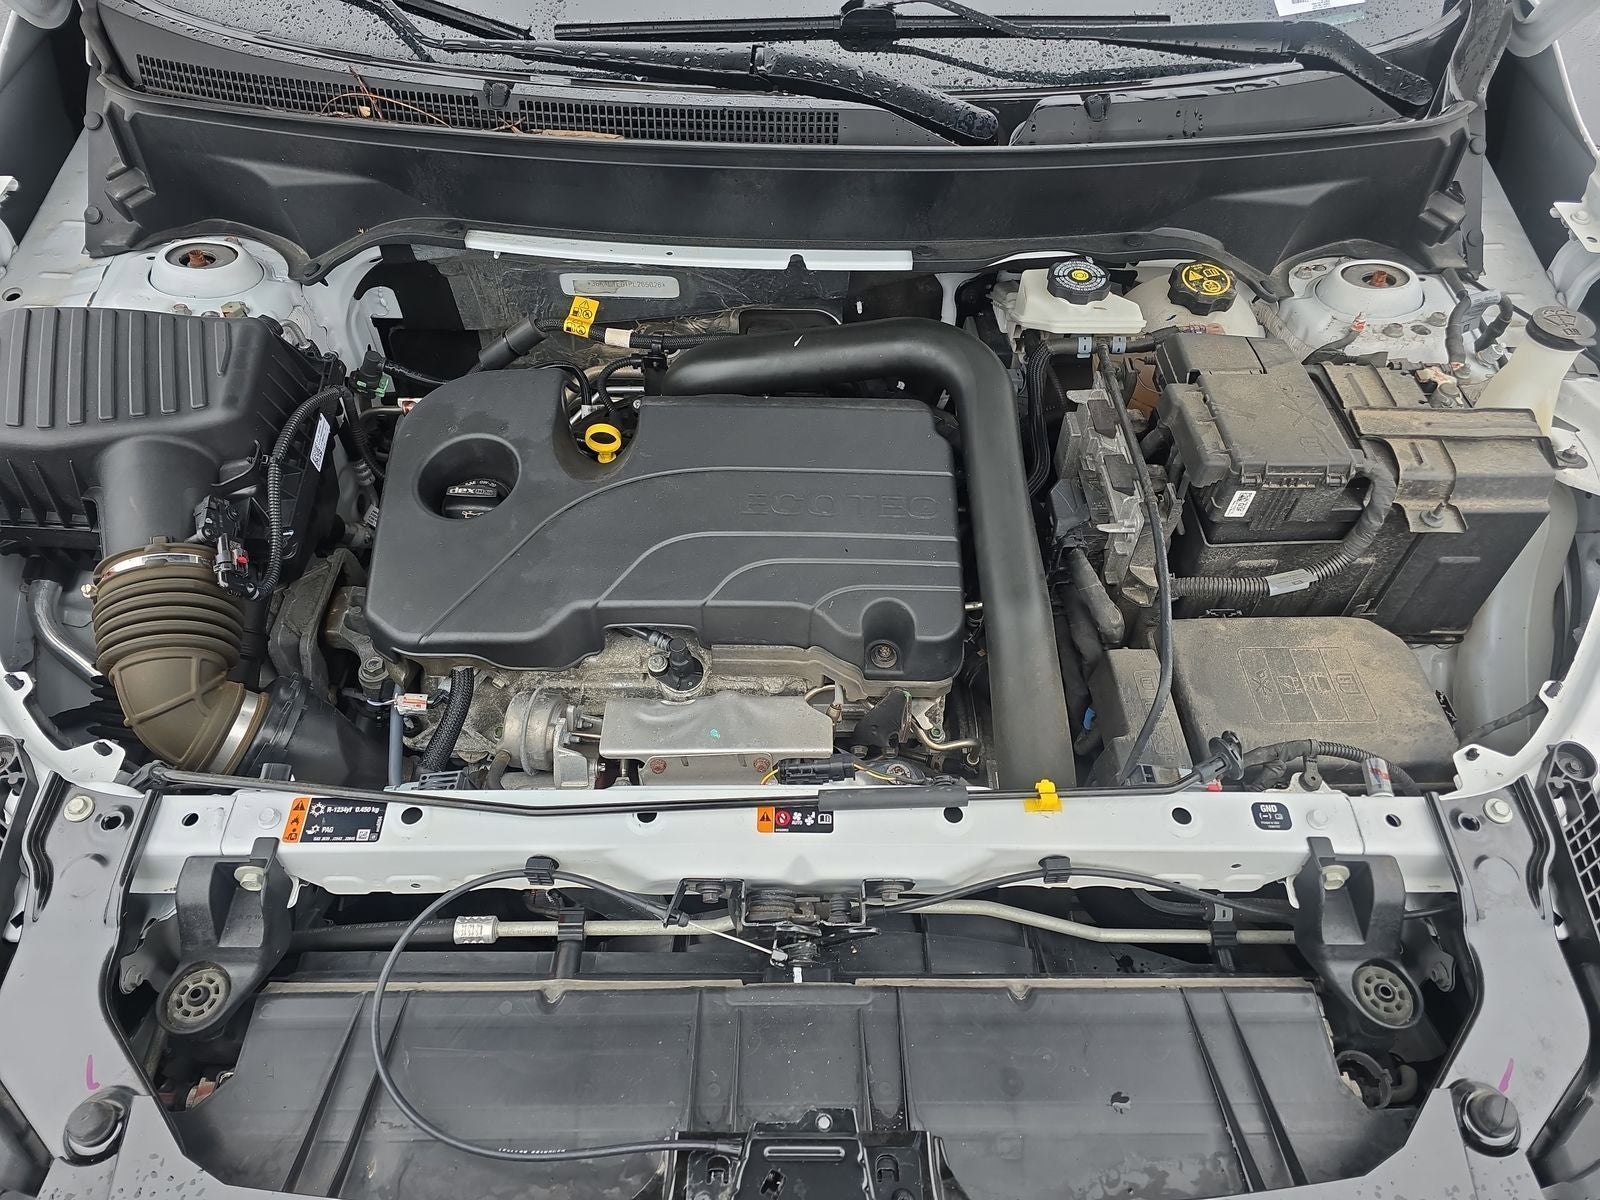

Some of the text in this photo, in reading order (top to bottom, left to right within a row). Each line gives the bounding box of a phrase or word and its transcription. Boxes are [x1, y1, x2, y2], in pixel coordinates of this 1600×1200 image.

[740, 493, 940, 520] ECOTEC
[326, 806, 353, 814] R-1234yf
[371, 806, 380, 814] kg
[1260, 804, 1278, 813] GND
